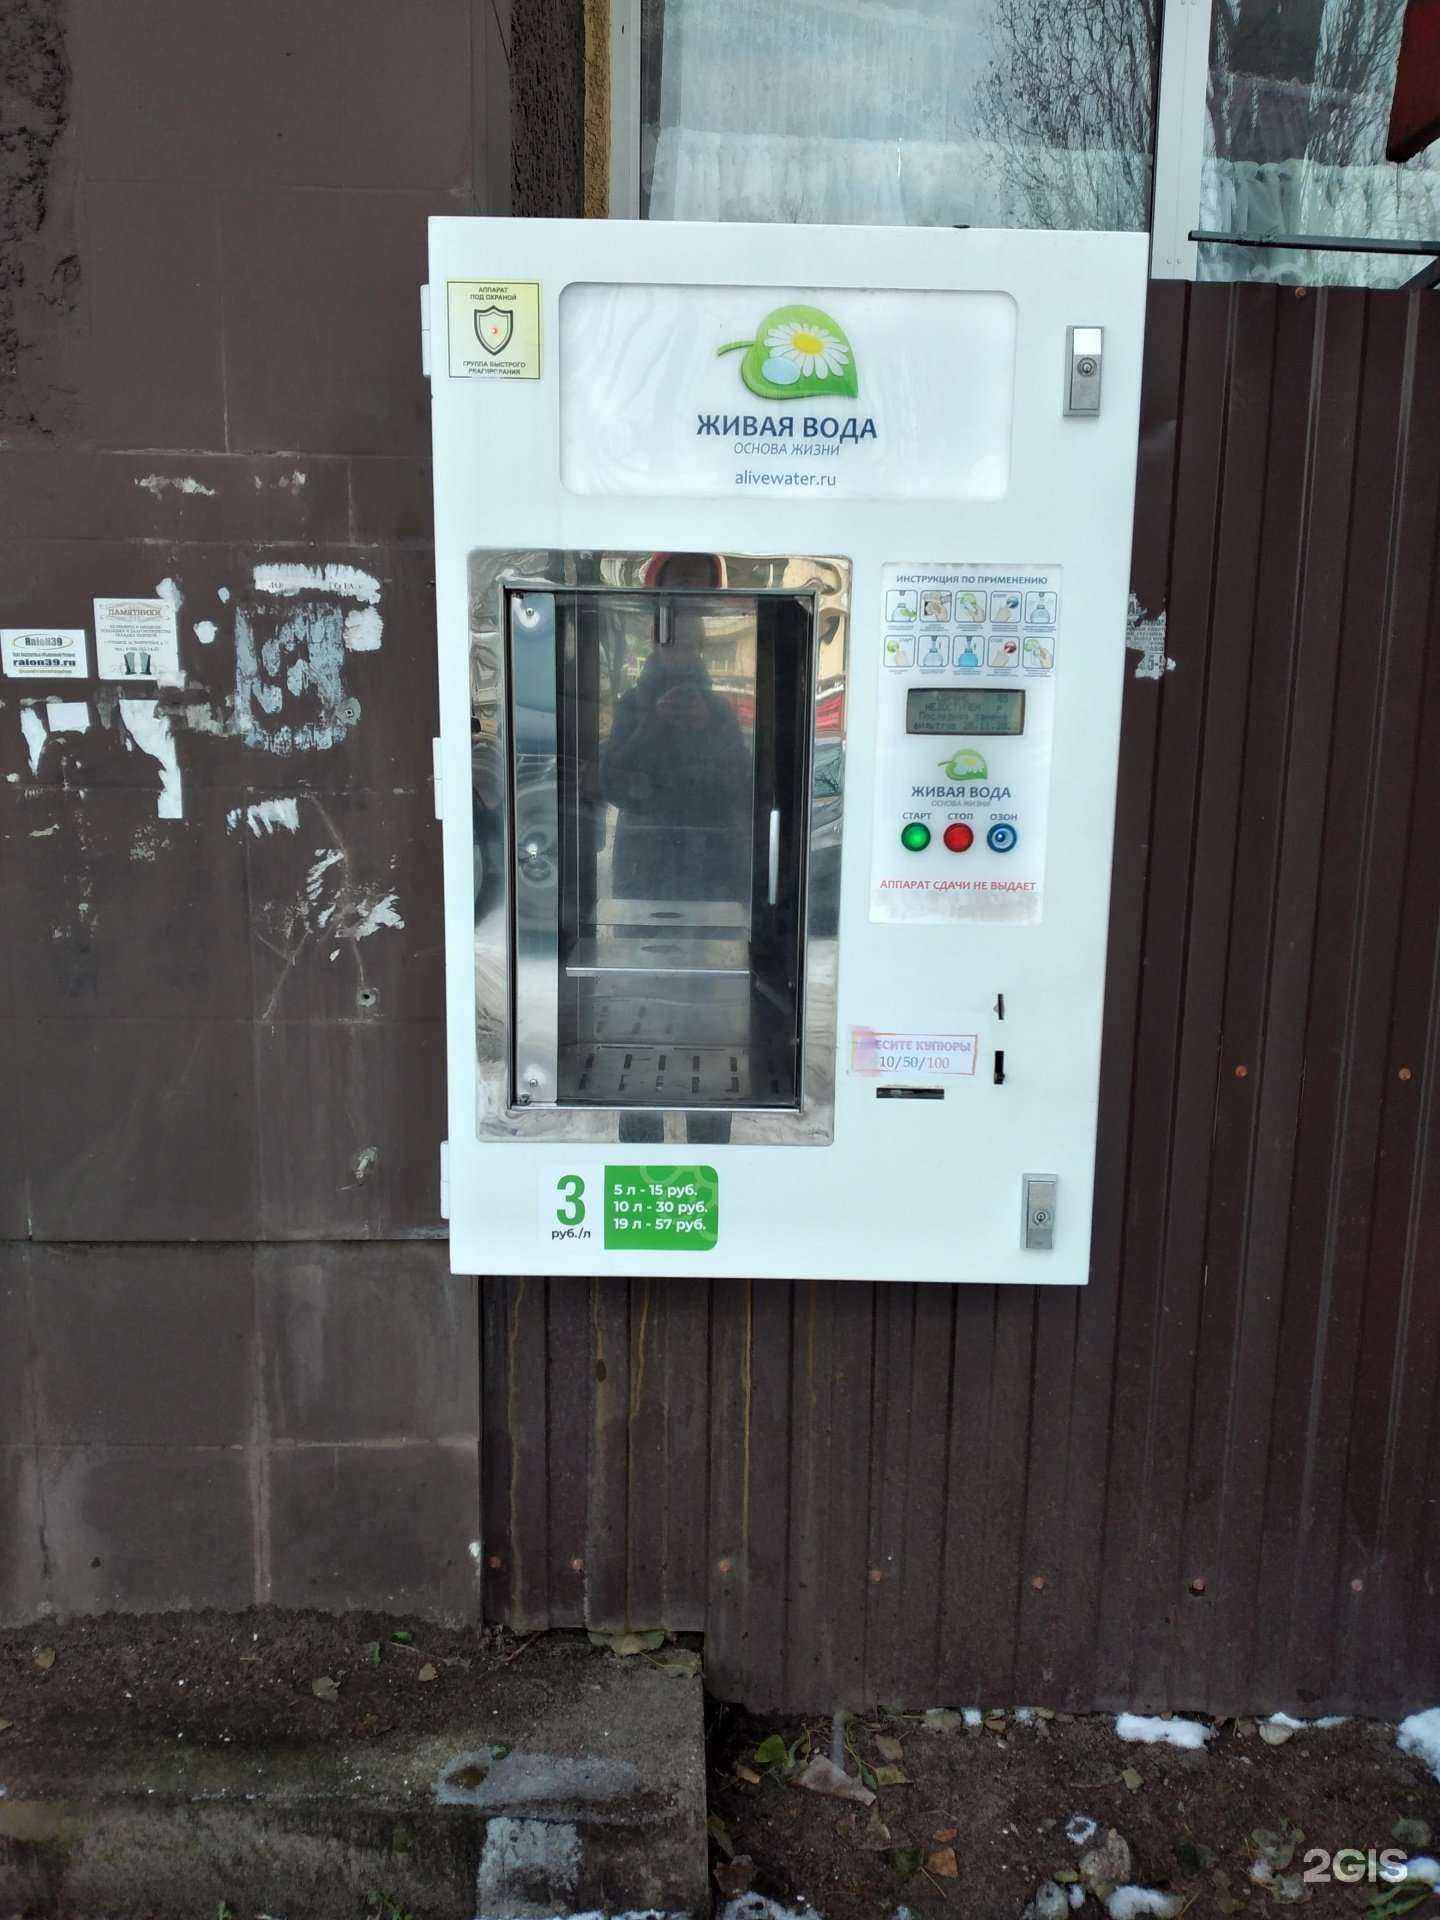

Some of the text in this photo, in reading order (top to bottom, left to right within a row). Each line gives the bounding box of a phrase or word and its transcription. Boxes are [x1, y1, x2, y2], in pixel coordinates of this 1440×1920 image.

[696, 414, 878, 444] ЖИВАЯ ВОДА
[734, 442, 841, 456] ОСНОВА ЖИЗНИ
[735, 470, 837, 487] alivewater.ru
[896, 575, 1048, 585] ИНСТРУКЦИЯ ПО ПРИМЕНЕНИЮ
[911, 786, 1012, 800] ЖИВАЯ ВОДА
[902, 812, 932, 820] СТАРТ
[990, 813, 1018, 821] ОЗОН
[880, 880, 1037, 892] АППАРАТ СДАЧИ НЕ ВЫДАЕТ
[879, 1056, 951, 1070] 10/50/100
[614, 1184, 623, 1196] 5
[626, 1186, 636, 1196] л
[649, 1184, 663, 1196] 15
[667, 1184, 697, 1197] руб.
[556, 1174, 586, 1226] 3
[613, 1201, 629, 1213] 10
[632, 1203, 643, 1213] л
[656, 1201, 674, 1213] 30
[678, 1201, 708, 1215] руб.
[613, 1218, 629, 1230] 19
[632, 1220, 642, 1230] л
[655, 1218, 672, 1230] 57
[676, 1218, 706, 1232] руб.
[551, 1227, 591, 1240] руб./л
